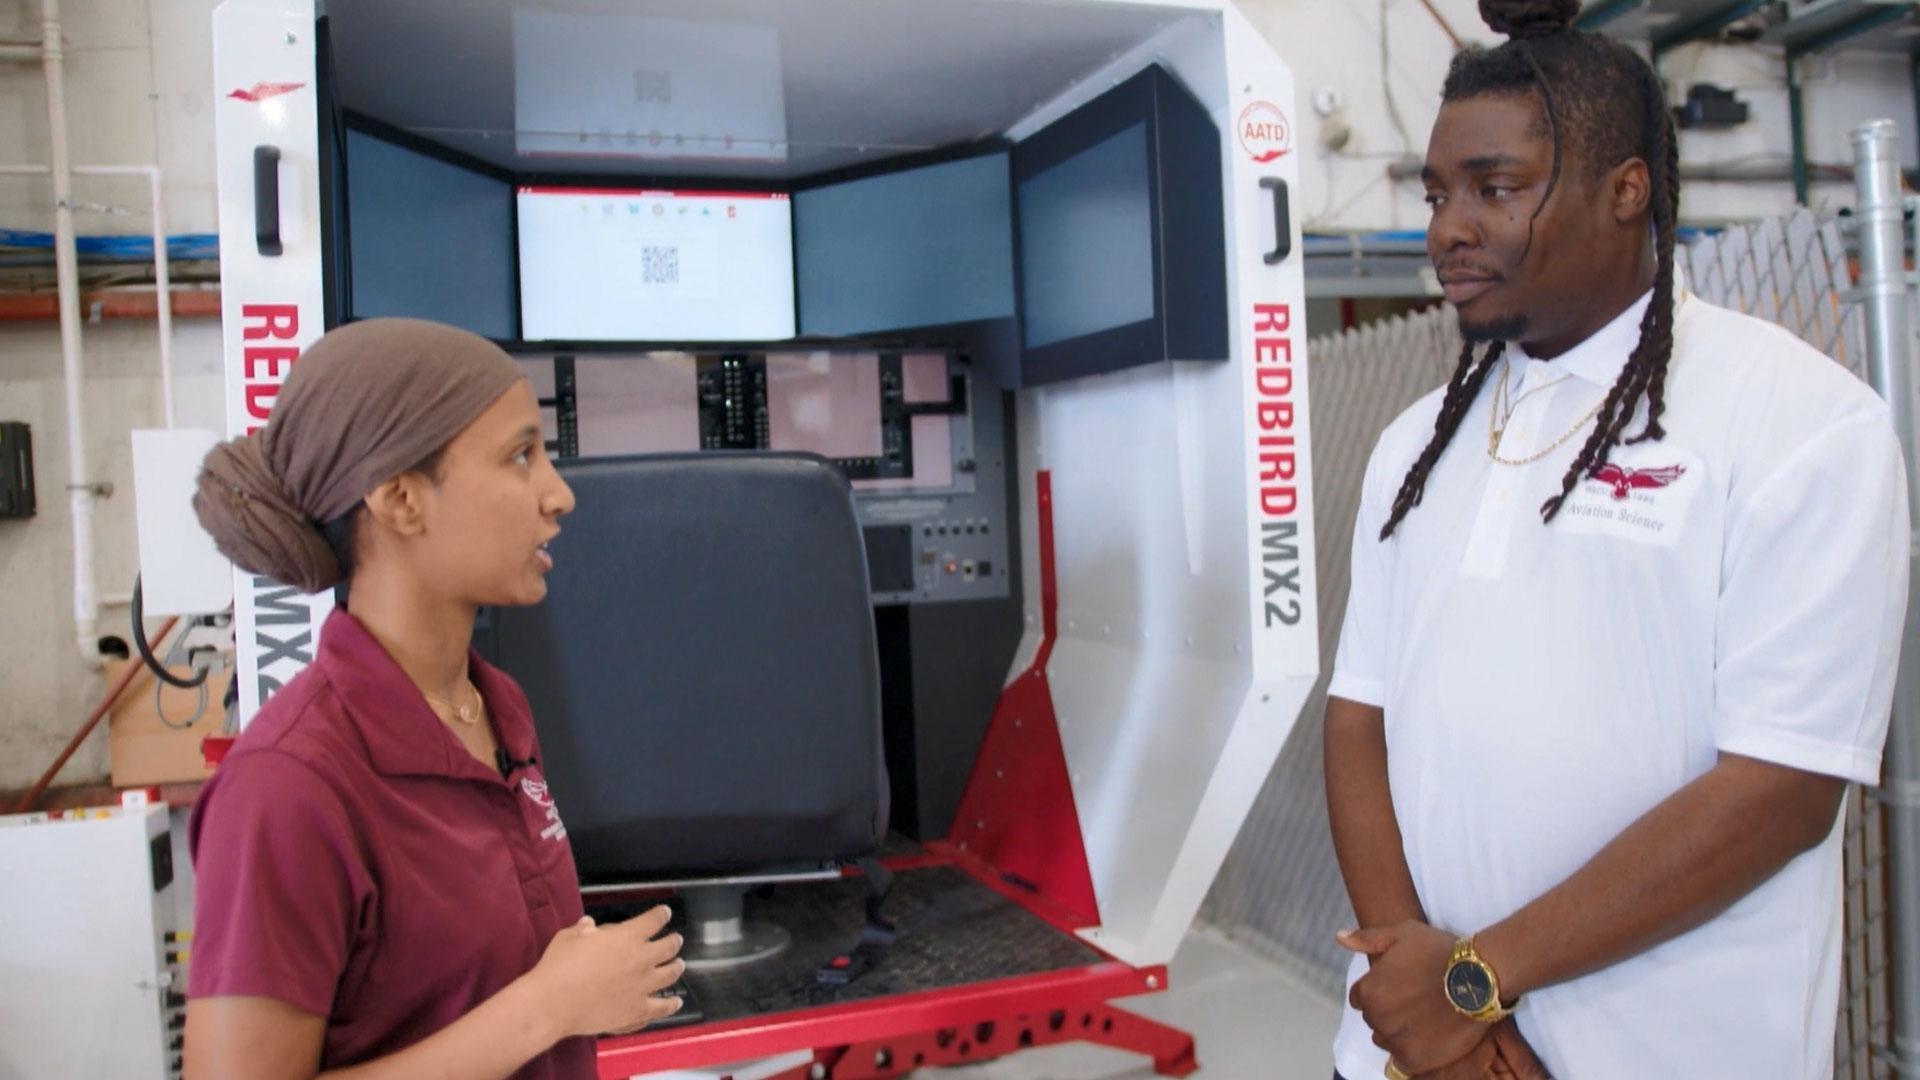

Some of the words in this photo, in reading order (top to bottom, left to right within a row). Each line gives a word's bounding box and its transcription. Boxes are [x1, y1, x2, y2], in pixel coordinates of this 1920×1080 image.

[1244, 122, 1284, 141] AATD
[1568, 502, 1614, 520] Aviation
[1617, 507, 1665, 532] Science
